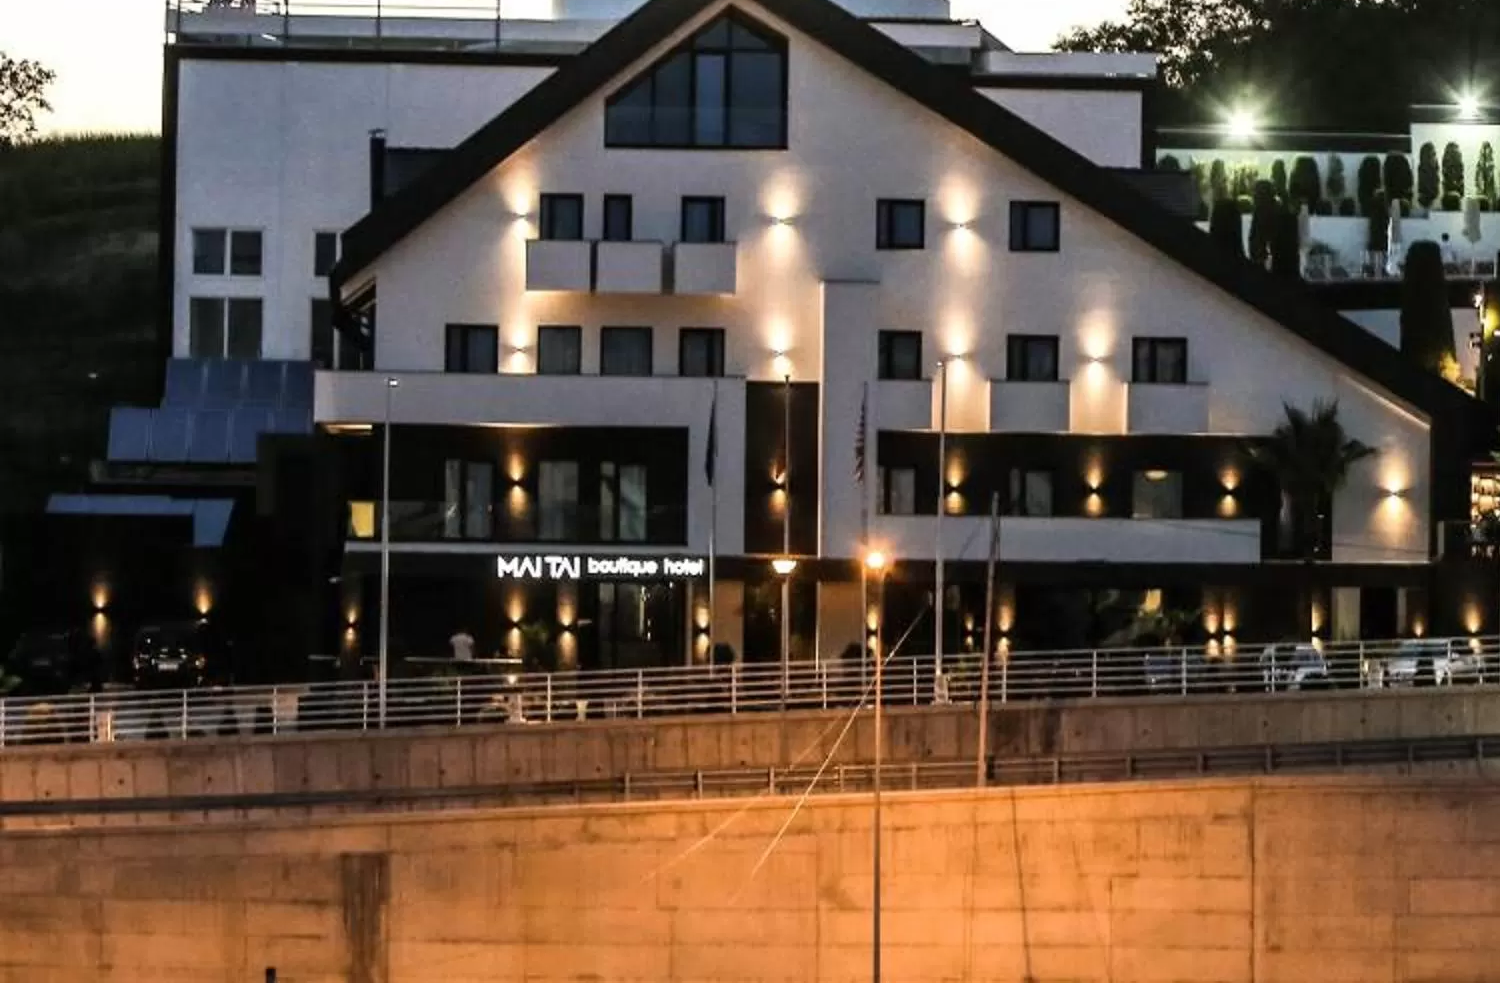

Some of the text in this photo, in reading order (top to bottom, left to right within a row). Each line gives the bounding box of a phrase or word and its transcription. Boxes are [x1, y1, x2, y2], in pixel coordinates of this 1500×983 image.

[497, 555, 703, 578] MAI TAI boutique hotel
